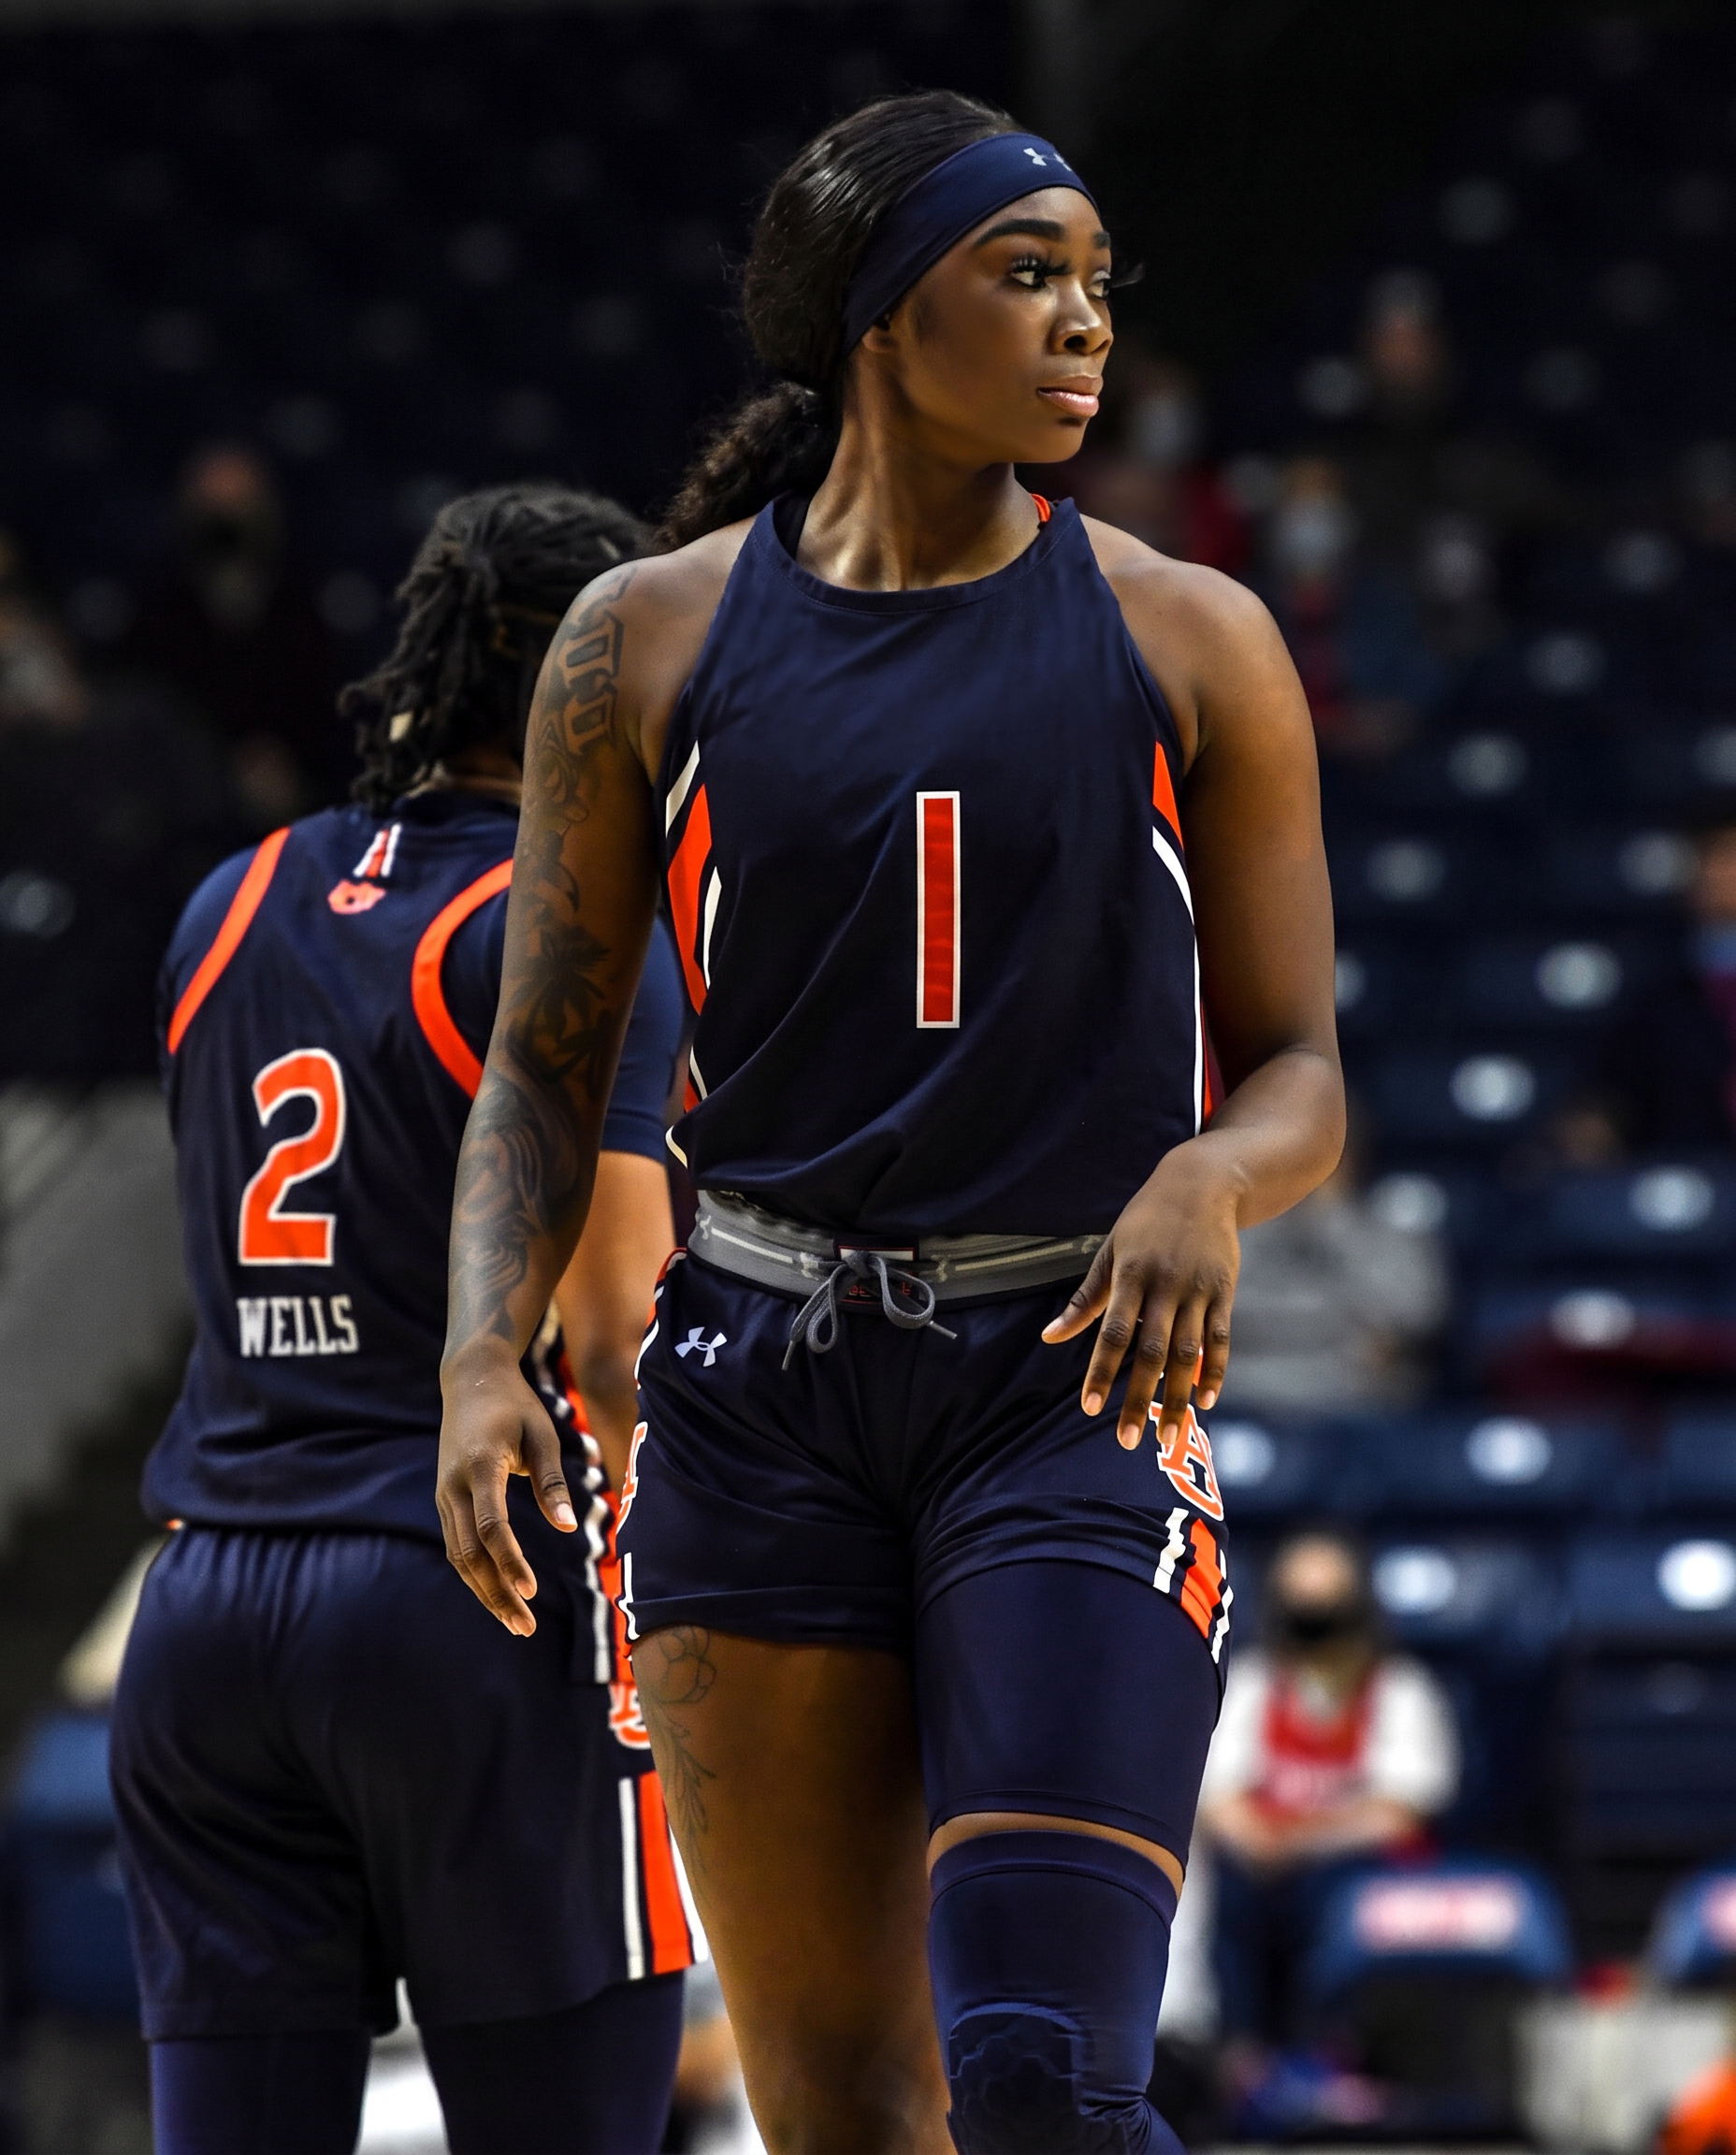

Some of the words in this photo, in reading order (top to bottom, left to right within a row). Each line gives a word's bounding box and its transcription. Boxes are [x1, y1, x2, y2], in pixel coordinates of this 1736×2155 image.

[917, 791, 961, 1029] 1
[239, 1048, 346, 1266] 2
[237, 1294, 359, 1357] WELLS
